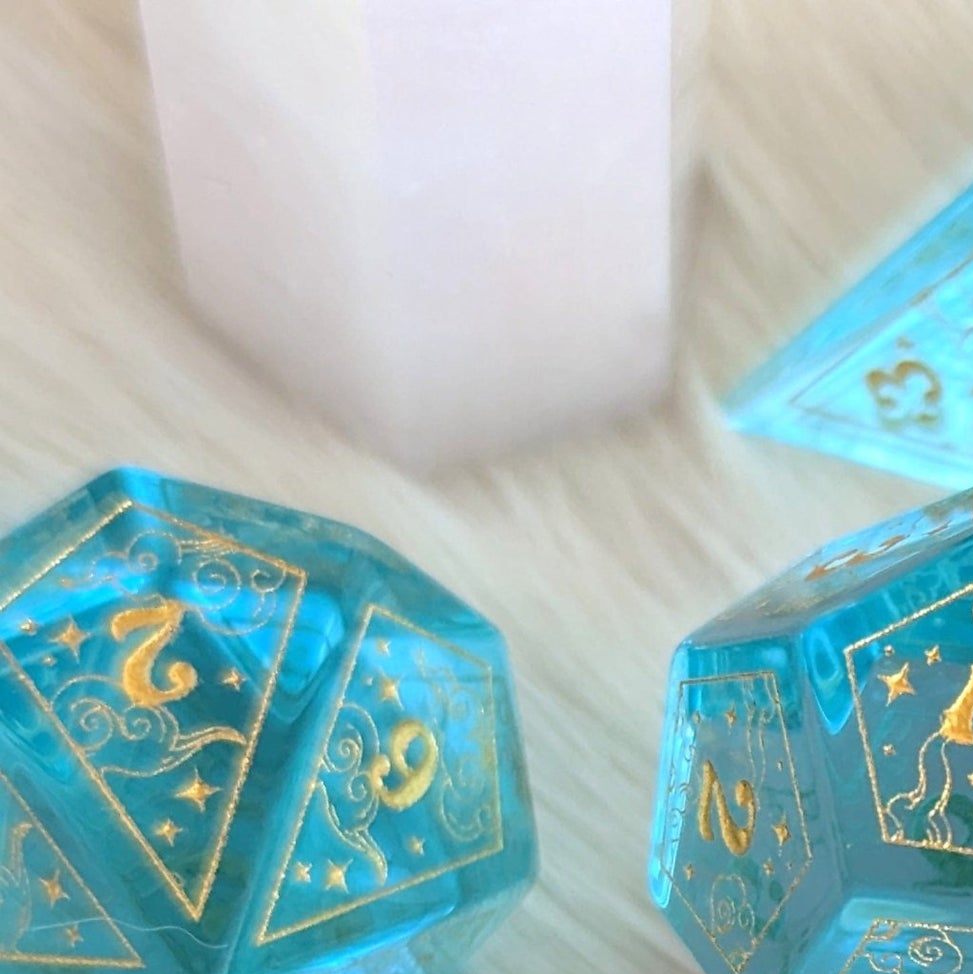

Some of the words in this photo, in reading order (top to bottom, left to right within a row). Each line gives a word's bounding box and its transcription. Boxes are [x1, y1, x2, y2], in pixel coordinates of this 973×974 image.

[864, 360, 942, 428] 3
[109, 599, 198, 707] 2
[698, 760, 758, 856] 2
